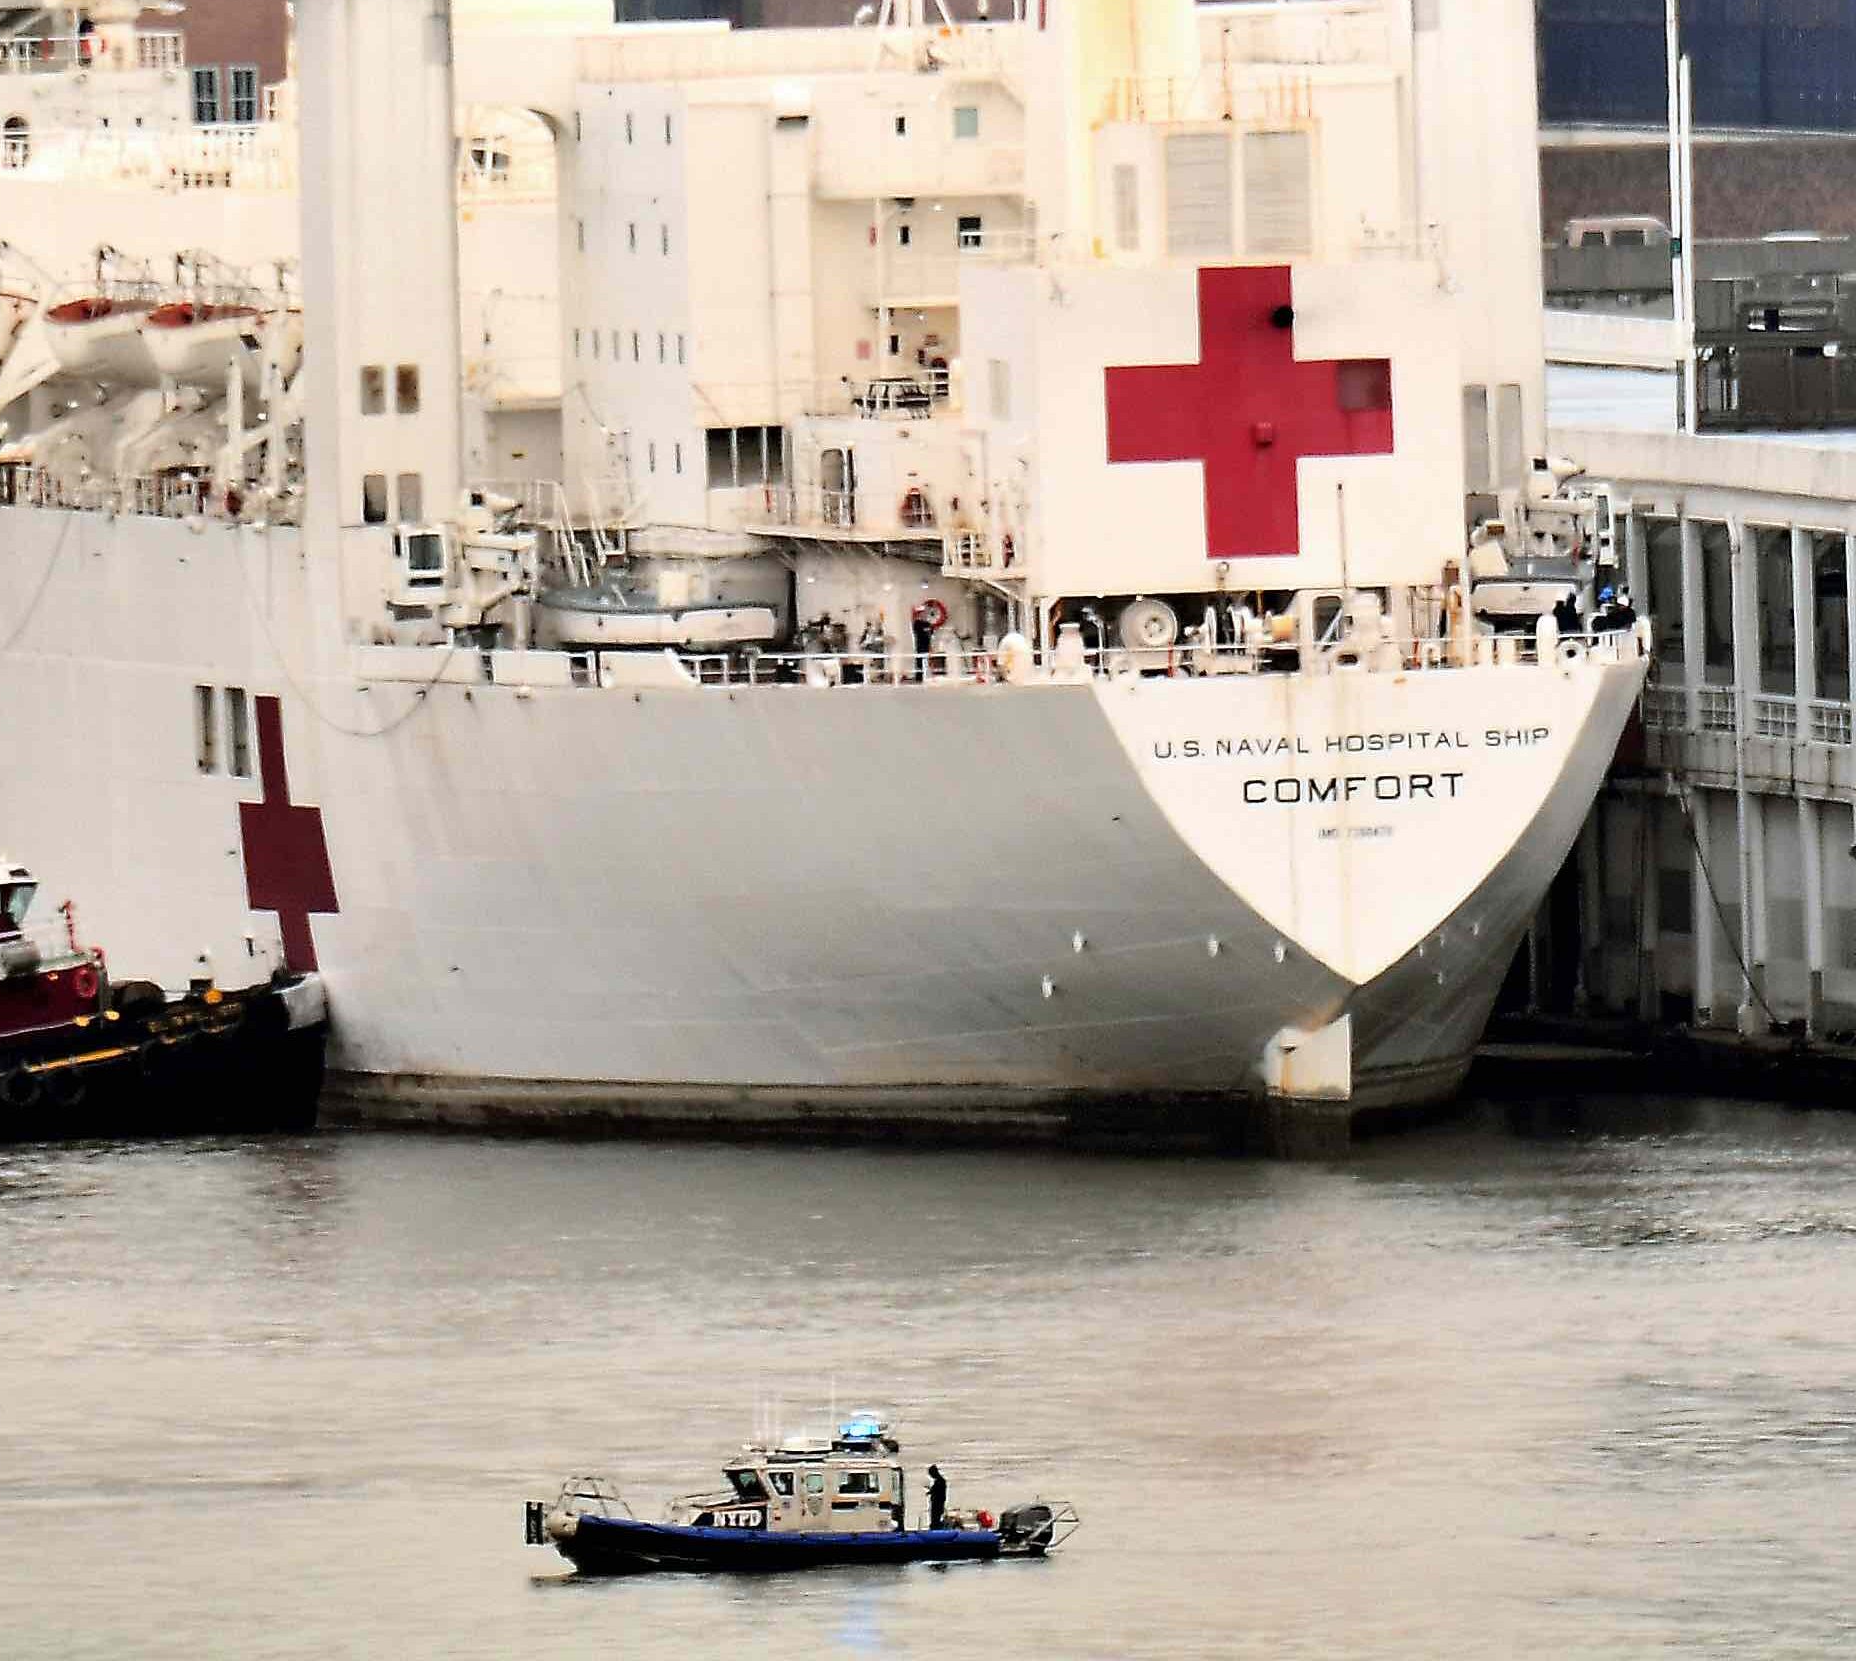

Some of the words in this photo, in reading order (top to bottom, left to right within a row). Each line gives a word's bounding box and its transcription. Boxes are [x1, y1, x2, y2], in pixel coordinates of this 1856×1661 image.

[1154, 739, 1206, 759] U.S.
[1215, 737, 1310, 756] NAVAL
[1325, 731, 1469, 752] HOSPITAL
[1484, 727, 1551, 747] SHIP
[1243, 772, 1464, 804] COMFORT
[713, 1510, 762, 1527] NYPD
